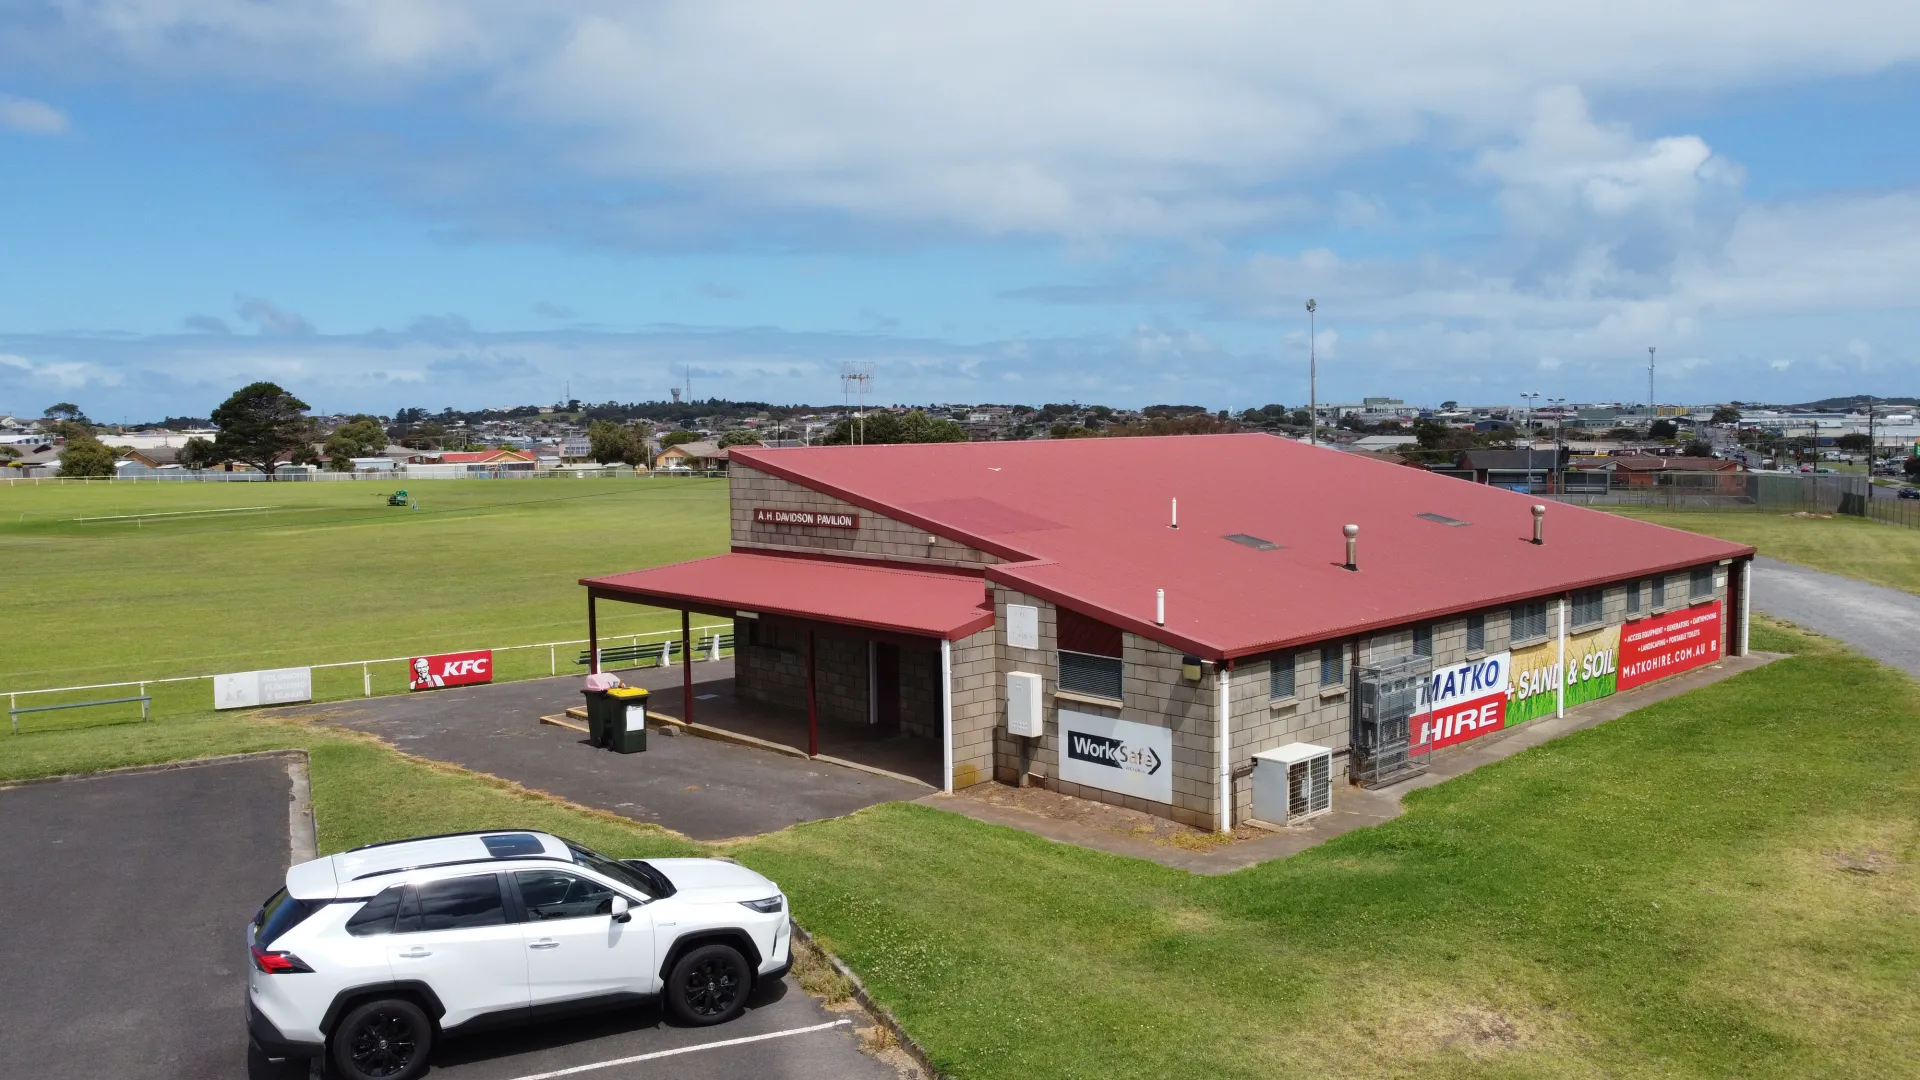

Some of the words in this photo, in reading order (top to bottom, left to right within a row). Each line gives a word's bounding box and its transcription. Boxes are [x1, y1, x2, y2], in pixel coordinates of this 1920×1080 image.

[776, 513, 813, 524] DAVIDSON
[817, 514, 852, 526] PAVILION
[1666, 620, 1690, 632] GENERATORS
[1692, 612, 1717, 625] EARTHMOVING
[441, 658, 488, 677] KFC
[1567, 658, 1578, 686] &
[1582, 648, 1616, 681] SOIL
[1623, 643, 1705, 678] MATKOHIRE.COM.AU
[1420, 660, 1500, 706] MATKO
[1419, 701, 1499, 744] HIRE
